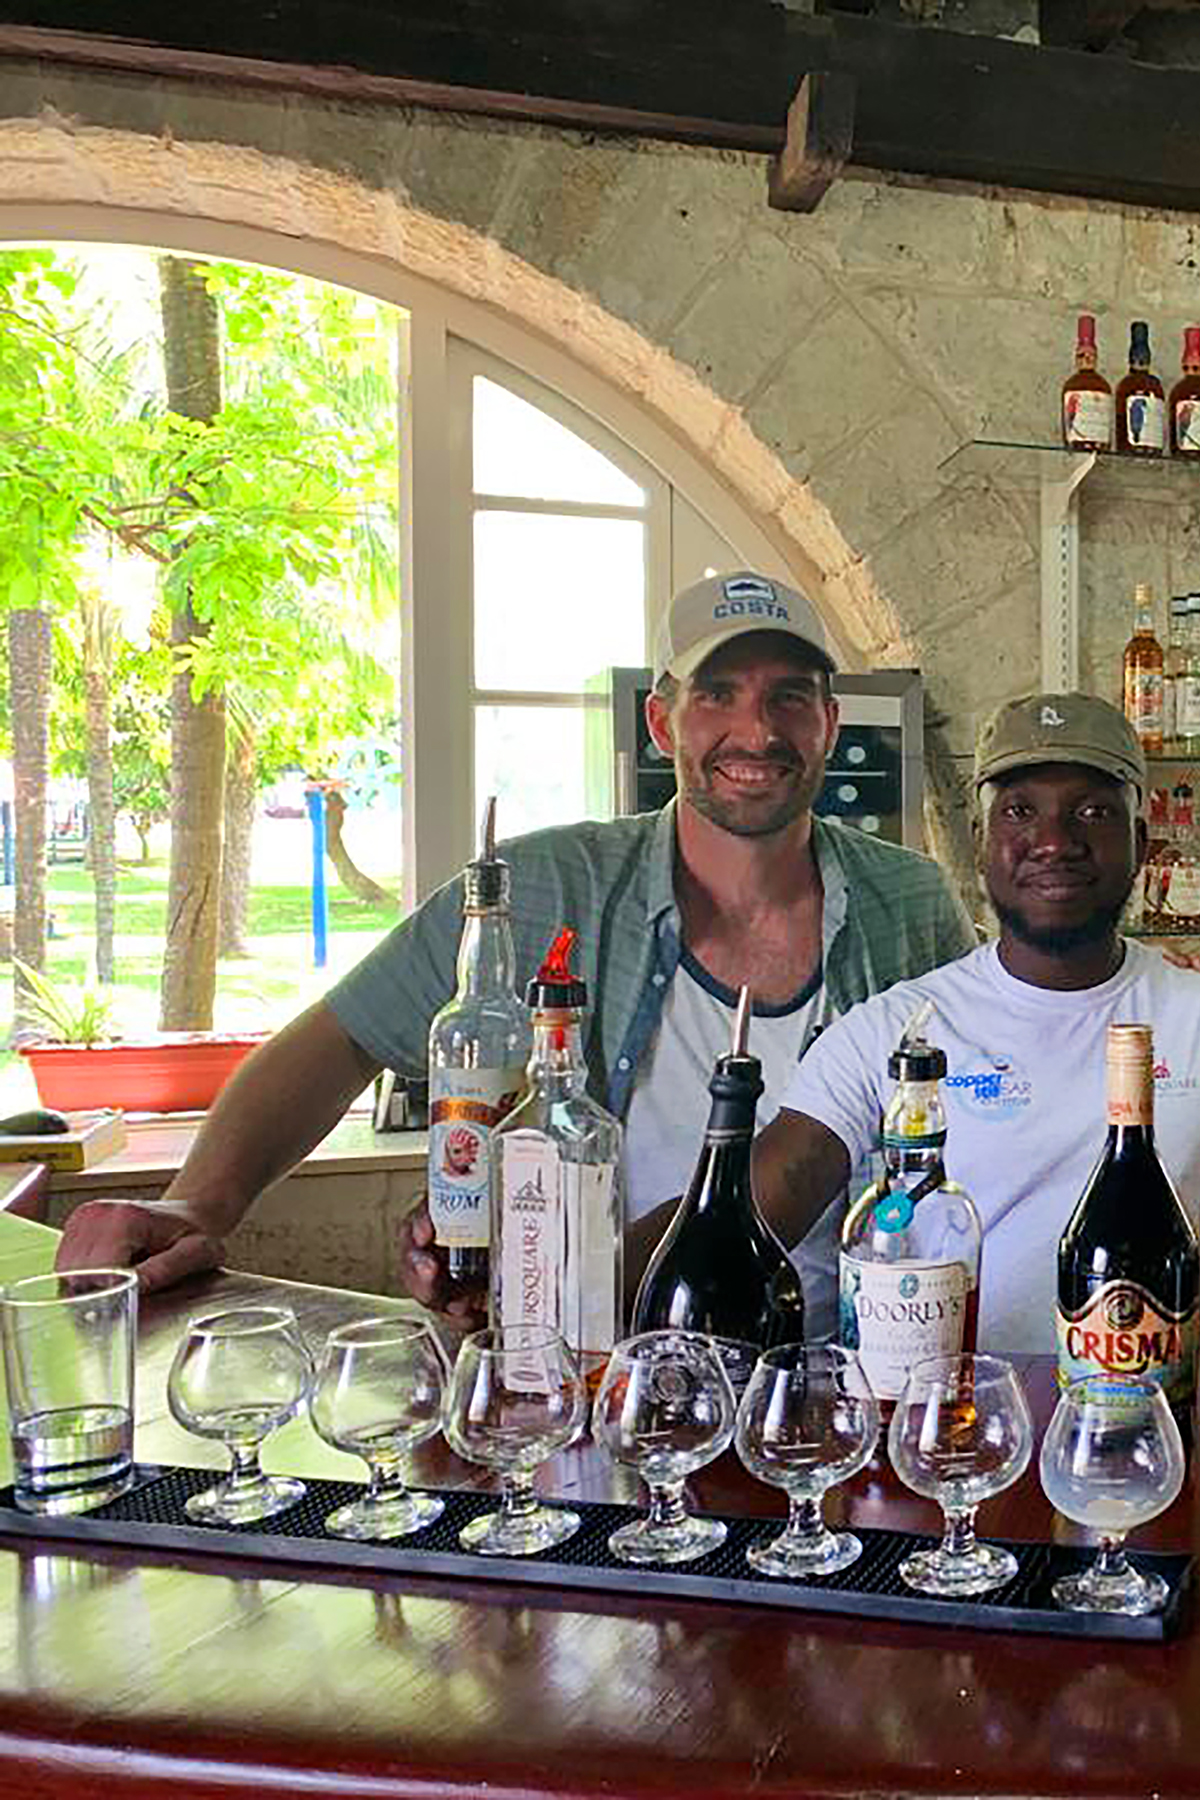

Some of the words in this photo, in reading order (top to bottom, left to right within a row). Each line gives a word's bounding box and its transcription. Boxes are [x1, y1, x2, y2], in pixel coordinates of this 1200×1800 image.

[713, 600, 791, 620] COSTA
[436, 1192, 482, 1211] RUM
[1066, 1325, 1182, 1365] CRISMA
